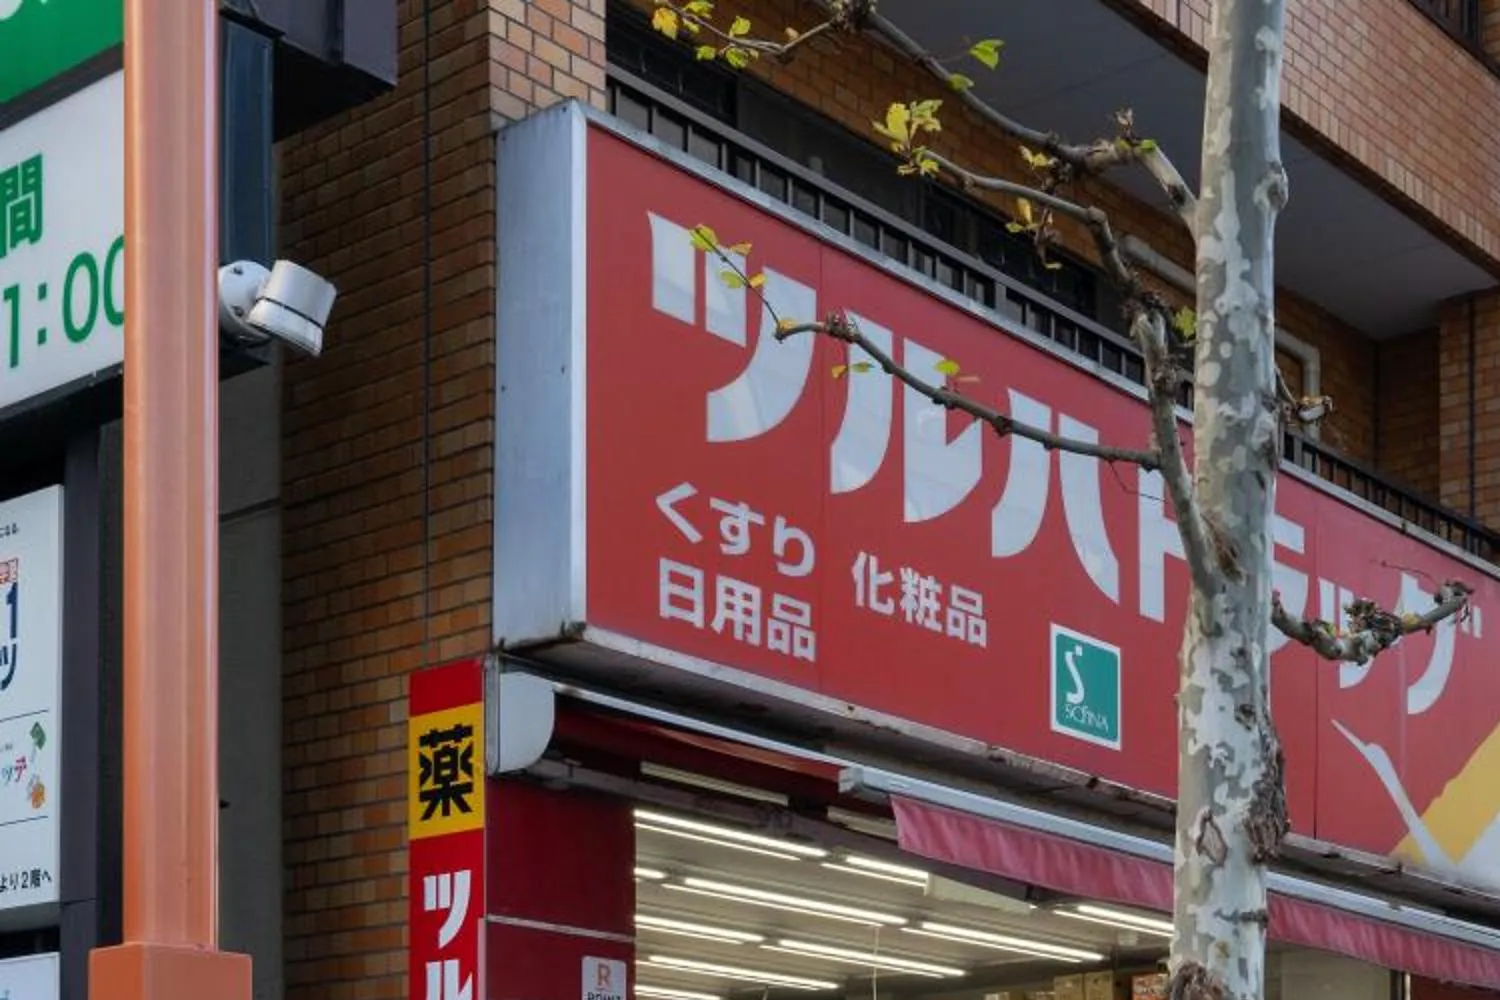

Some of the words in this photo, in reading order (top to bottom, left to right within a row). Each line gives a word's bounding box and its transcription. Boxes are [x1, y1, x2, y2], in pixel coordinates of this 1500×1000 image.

[0, 154, 42, 258] 間
[655, 481, 816, 577] くすり
[658, 557, 817, 662] 日用品
[851, 551, 988, 648] 化粧品
[419, 723, 474, 821] 薬
